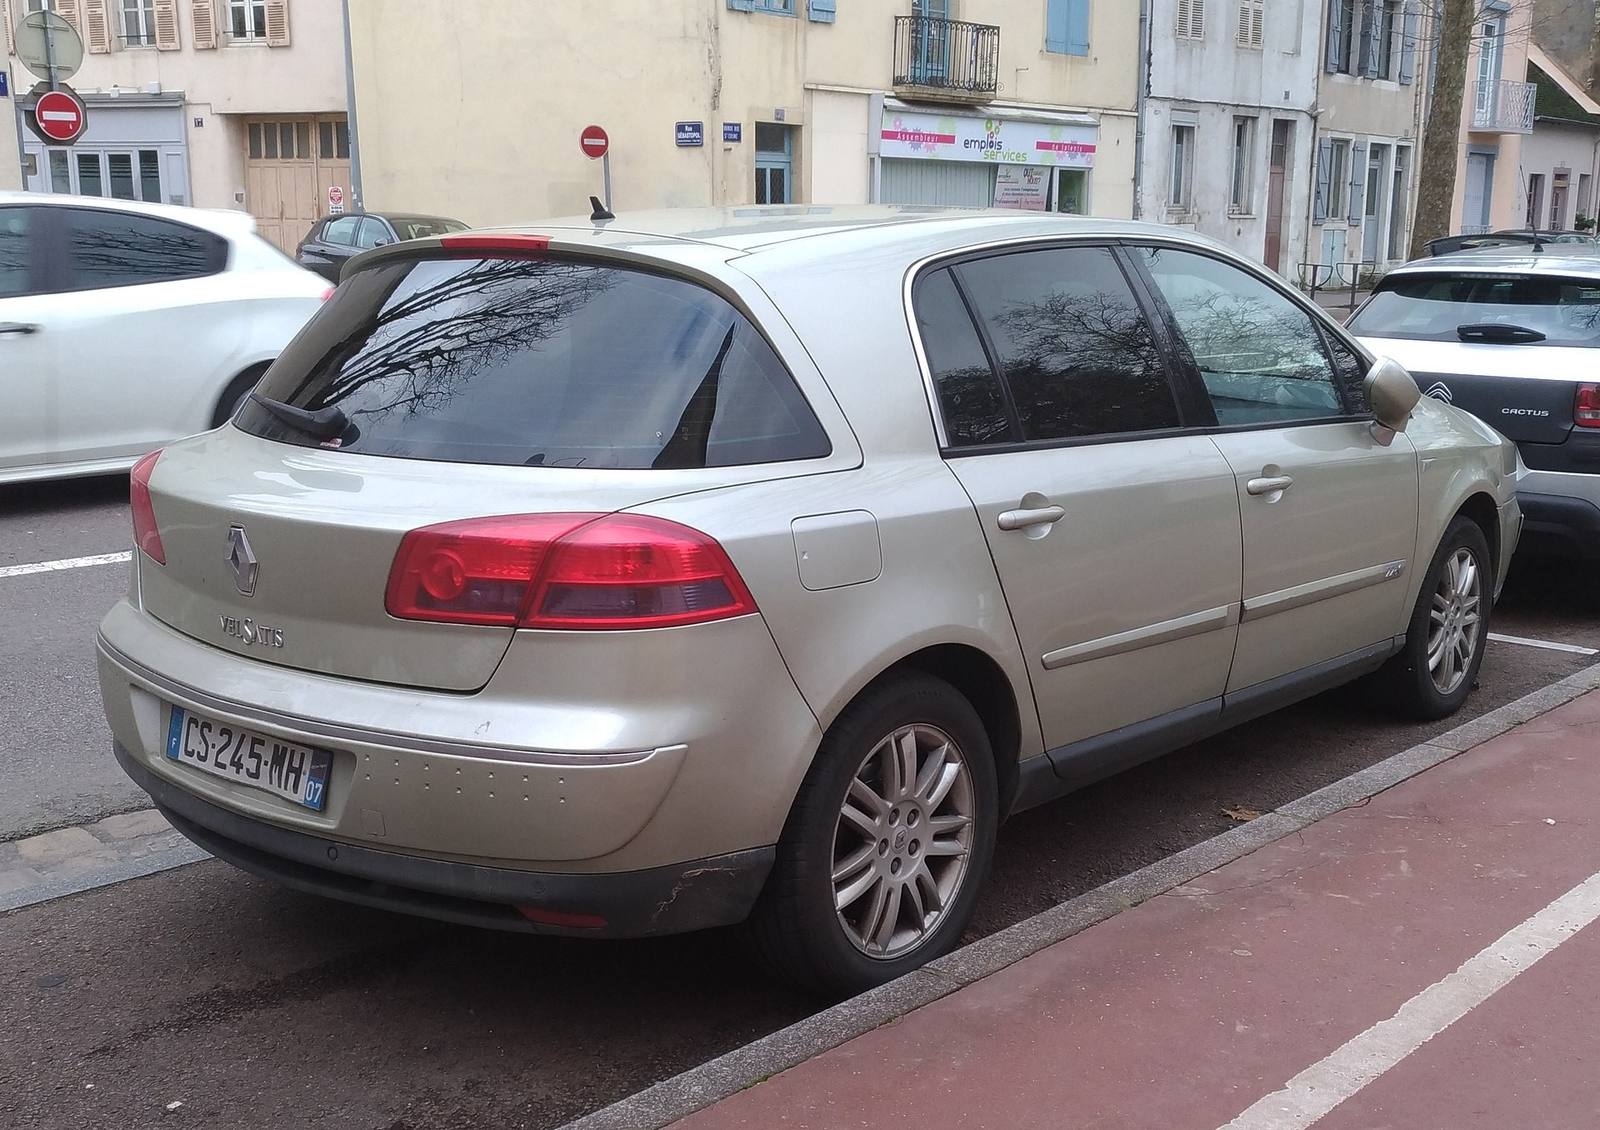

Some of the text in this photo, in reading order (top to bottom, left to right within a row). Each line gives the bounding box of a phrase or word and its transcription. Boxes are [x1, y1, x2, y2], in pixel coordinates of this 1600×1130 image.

[896, 132, 938, 143] Assembleur
[963, 133, 1003, 152] emplois
[983, 148, 1027, 162] services
[1500, 408, 1549, 417] CACTUS
[171, 738, 177, 749] F
[184, 717, 305, 794] CS-245-MH
[306, 781, 323, 803] 07
